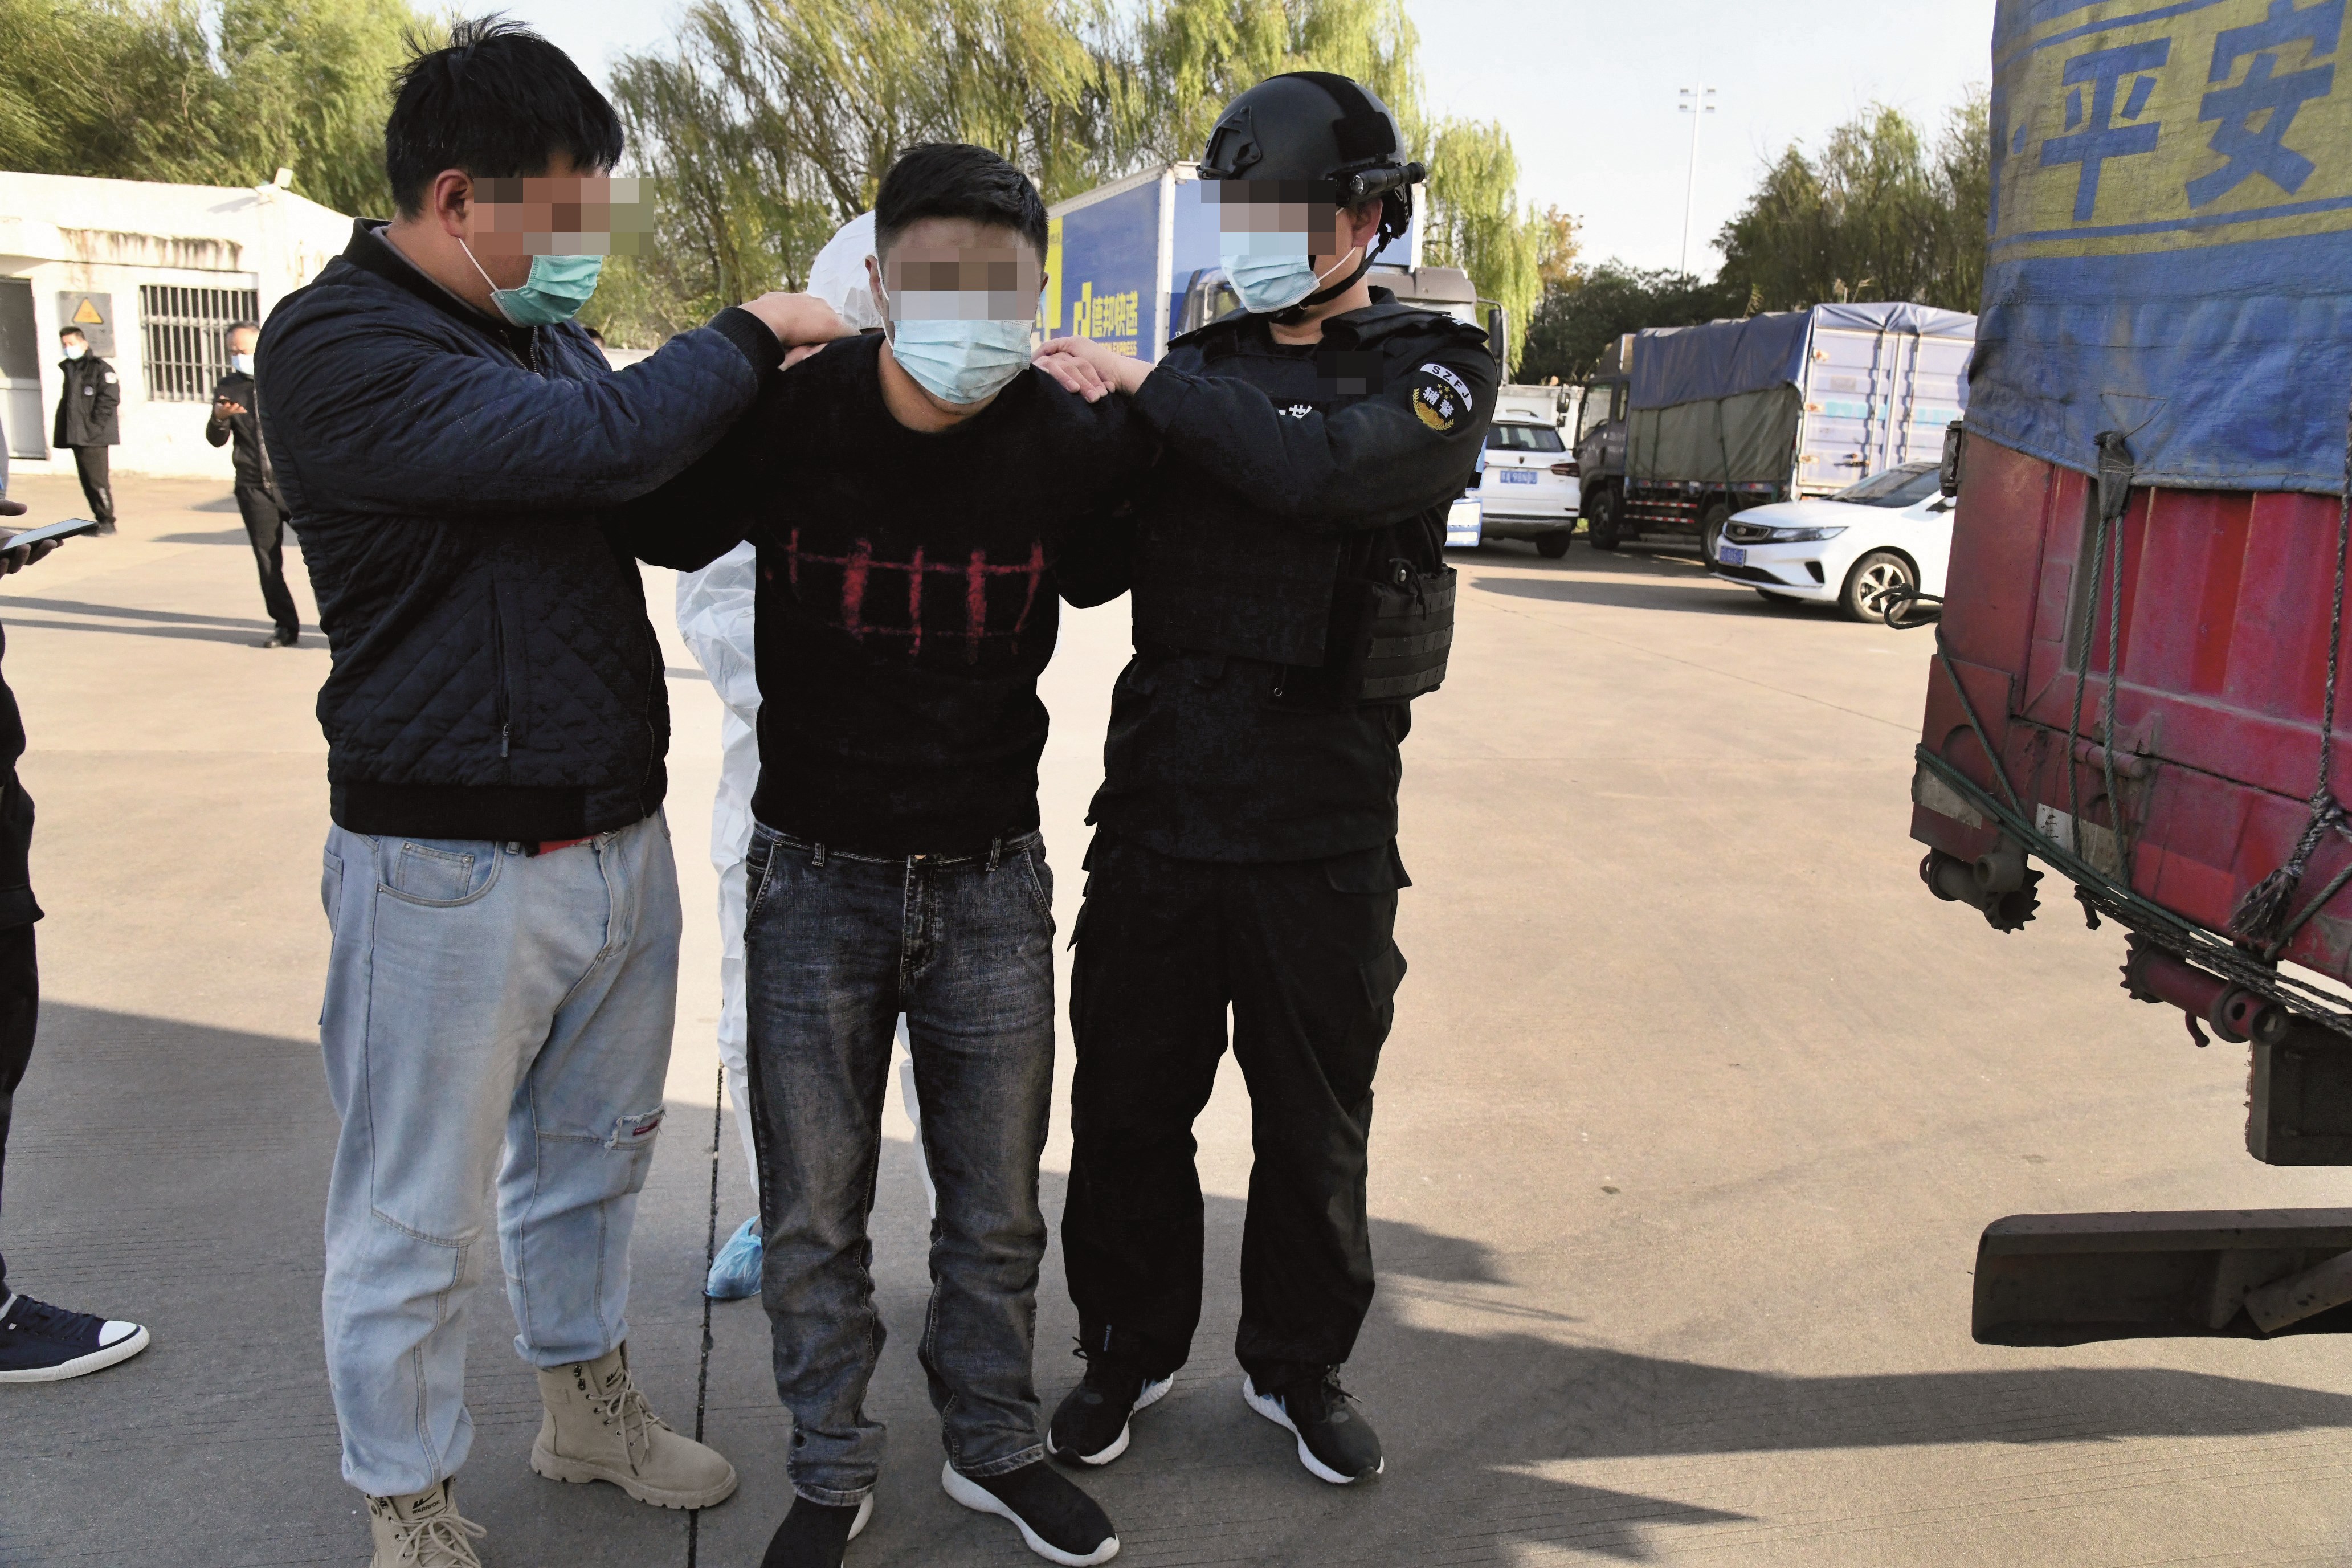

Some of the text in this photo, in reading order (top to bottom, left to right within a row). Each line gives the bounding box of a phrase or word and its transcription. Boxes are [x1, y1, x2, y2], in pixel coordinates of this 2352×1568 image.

[2040, 0, 2345, 222] 平安
[1431, 365, 1469, 399] SZFJ
[1422, 386, 1455, 418] 辅警
[411, 1500, 440, 1514] WARRIOR
